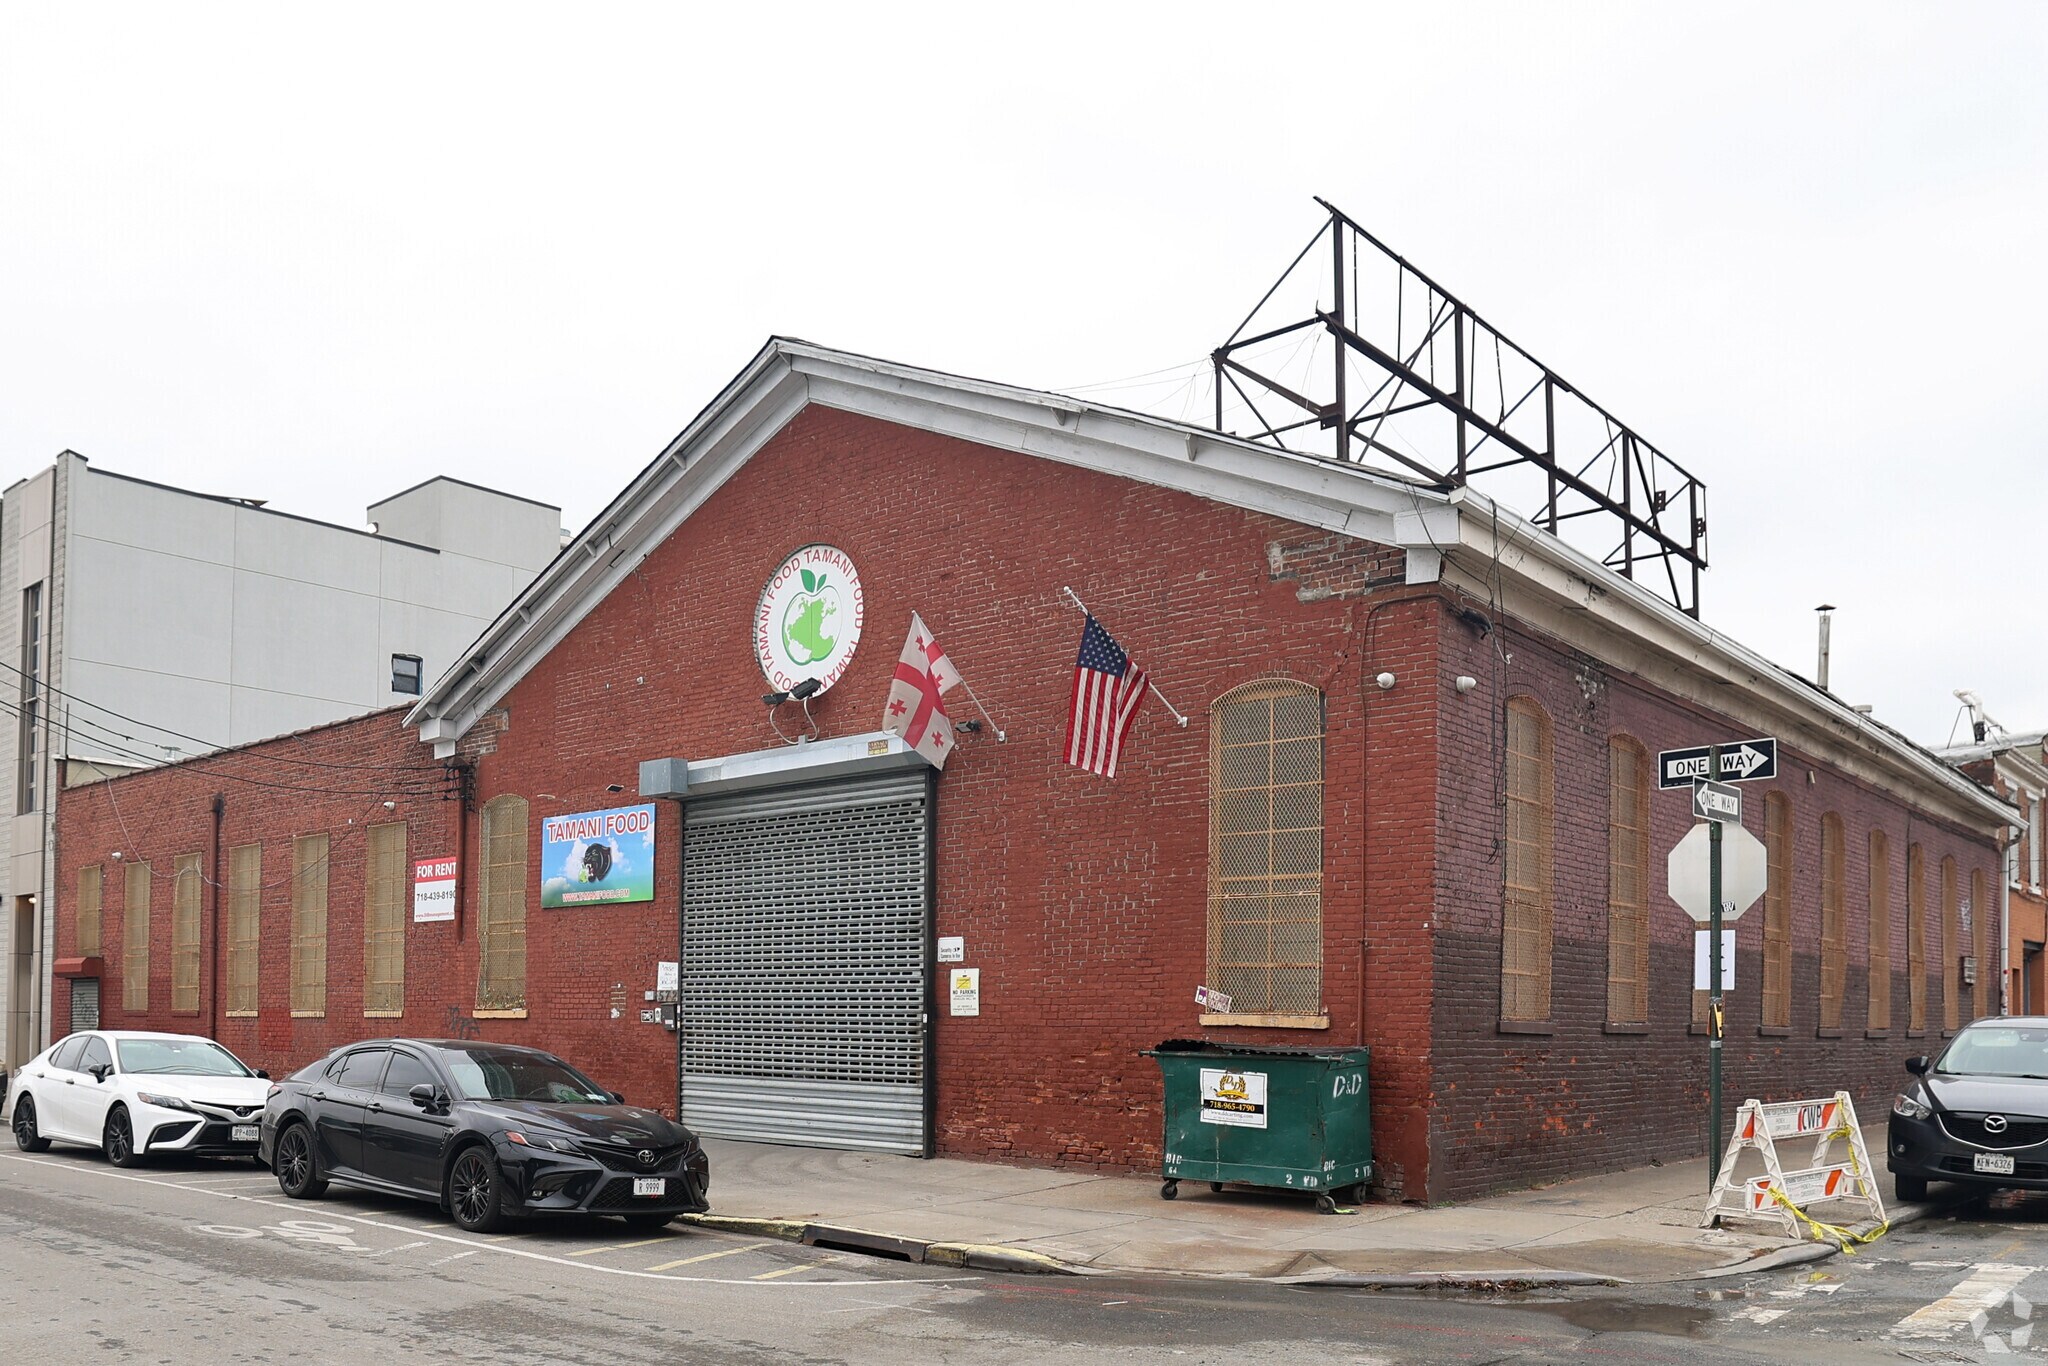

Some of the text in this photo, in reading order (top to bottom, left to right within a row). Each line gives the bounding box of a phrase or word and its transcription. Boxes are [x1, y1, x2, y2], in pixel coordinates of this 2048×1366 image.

[804, 549, 864, 629] TAMANI FOOD
[758, 557, 800, 672] TAMANI FOOD
[818, 640, 858, 689] TAMAN
[1676, 753, 1756, 775] ONE WAY
[1701, 791, 1736, 812] ONE WAY
[547, 811, 650, 842] TAMANI FOOD
[416, 862, 456, 878] FOR RENT
[1333, 1073, 1362, 1098] D&D
[1802, 1104, 1822, 1131] CWP
[646, 1182, 659, 1193] 9999
[1286, 1174, 1293, 1184] 2
